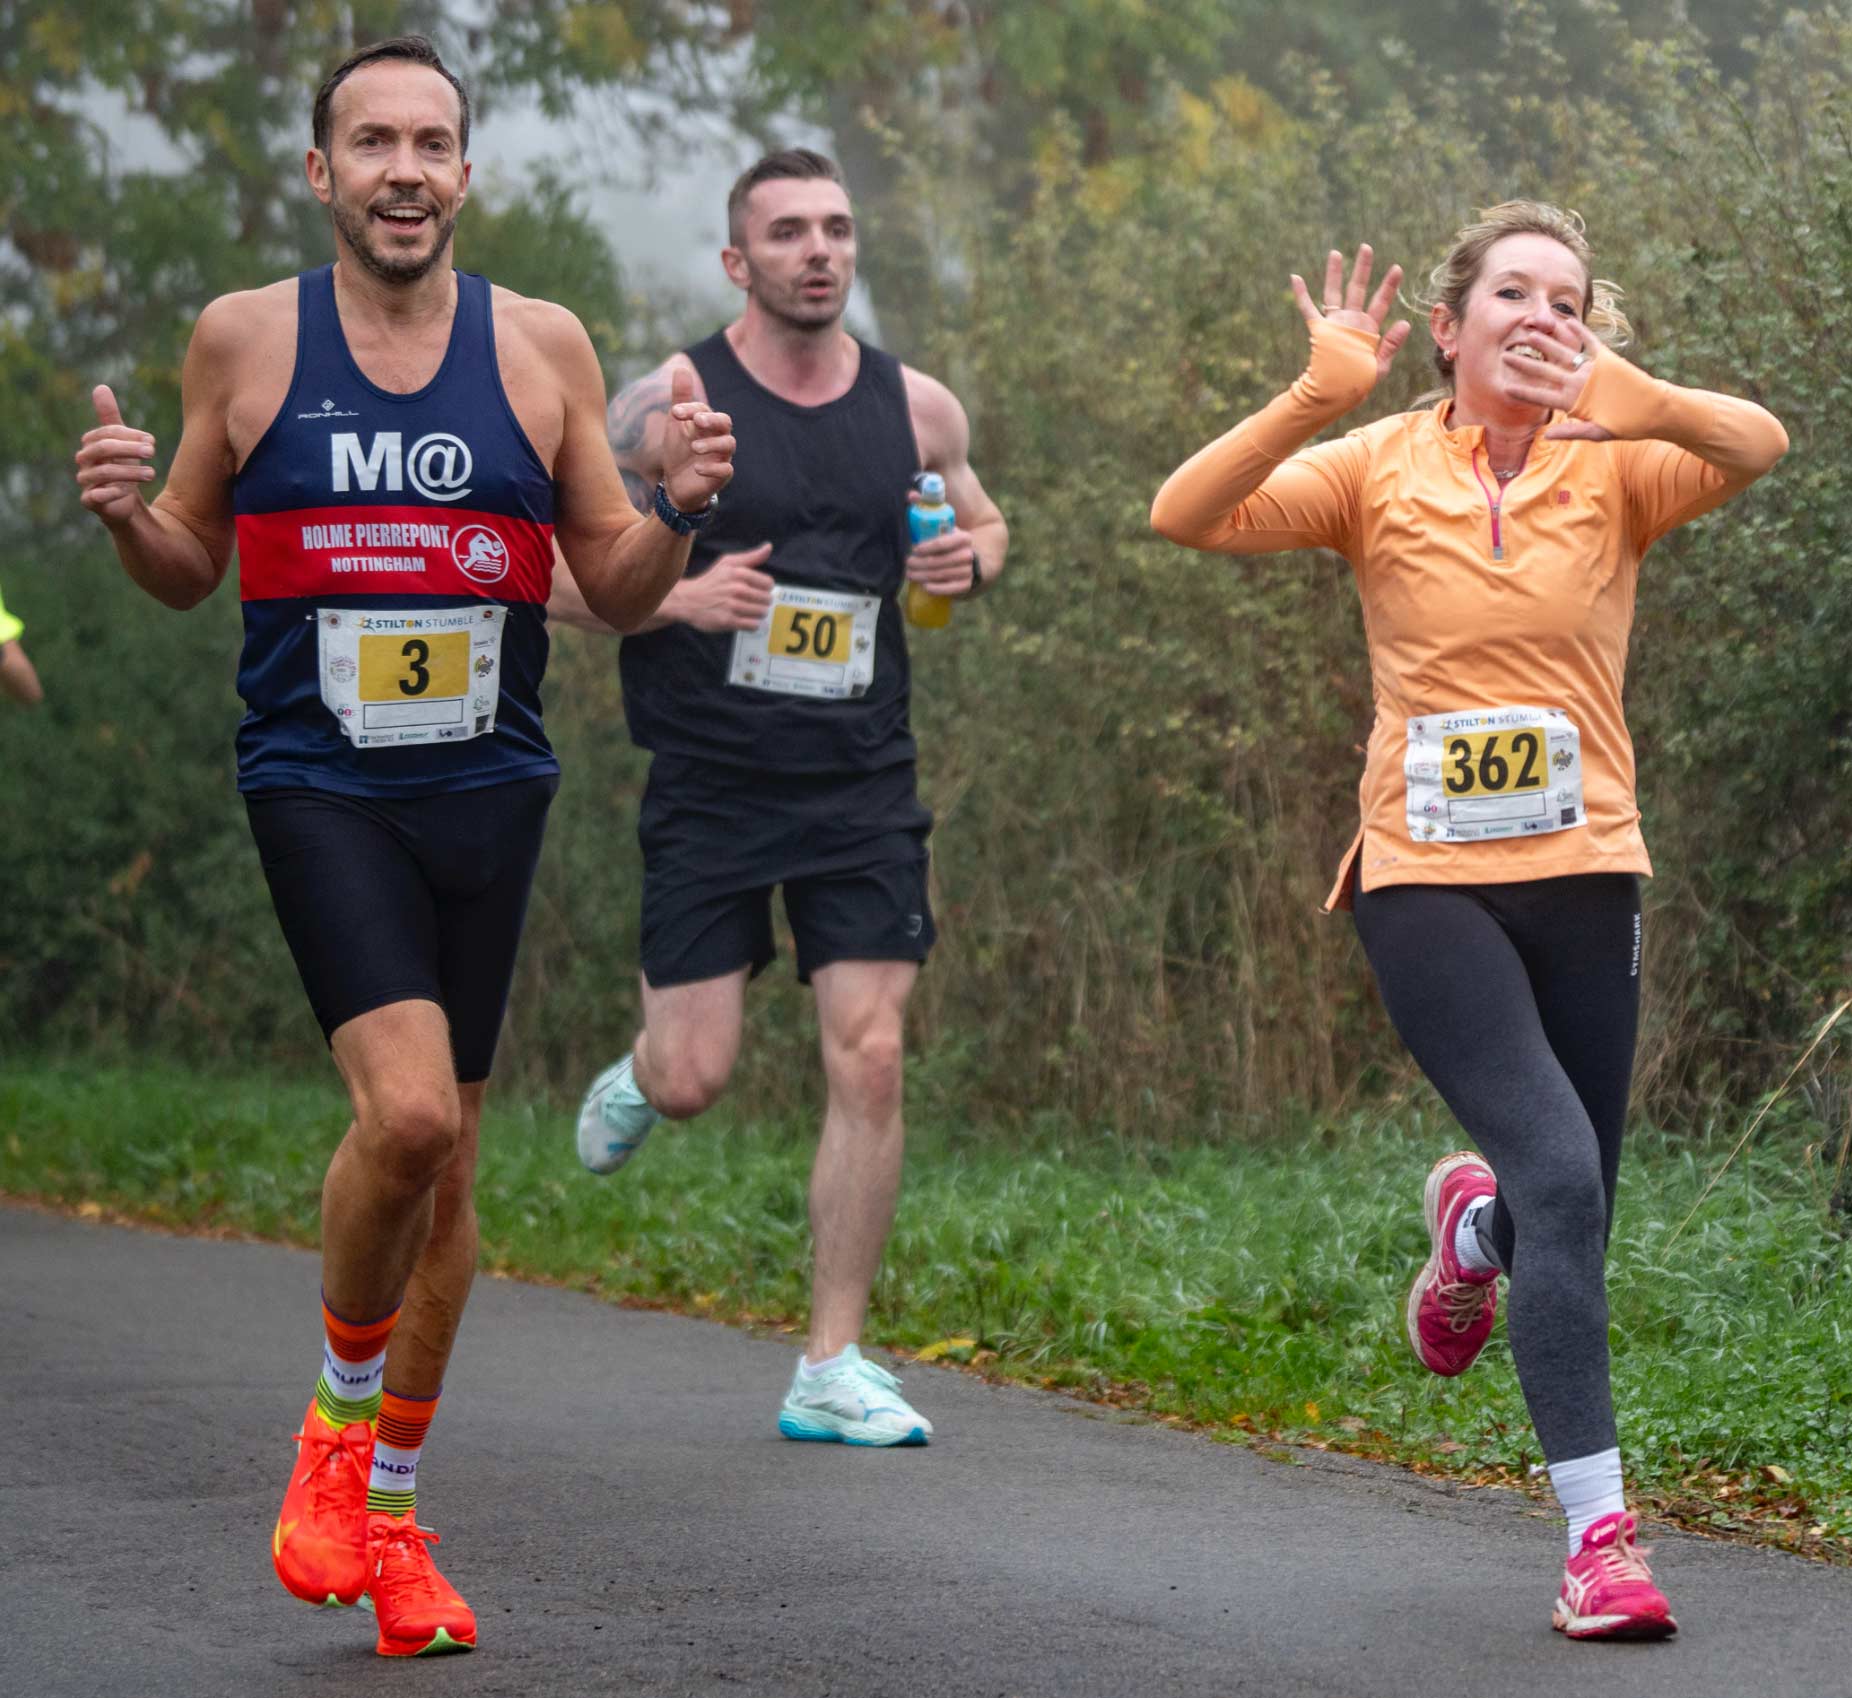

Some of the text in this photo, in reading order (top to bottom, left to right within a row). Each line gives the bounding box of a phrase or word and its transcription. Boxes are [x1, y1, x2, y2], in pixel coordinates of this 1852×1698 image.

[331, 431, 474, 503] M@
[301, 522, 450, 551] HOLME PIERREPONT
[331, 556, 426, 574] NOTTINGHAM
[375, 618, 423, 629] STILTON
[425, 615, 474, 628] STUMBLE
[785, 611, 837, 659] 50
[398, 638, 431, 696] 3
[1453, 715, 1496, 729] STILTON
[1446, 732, 1541, 794] 362
